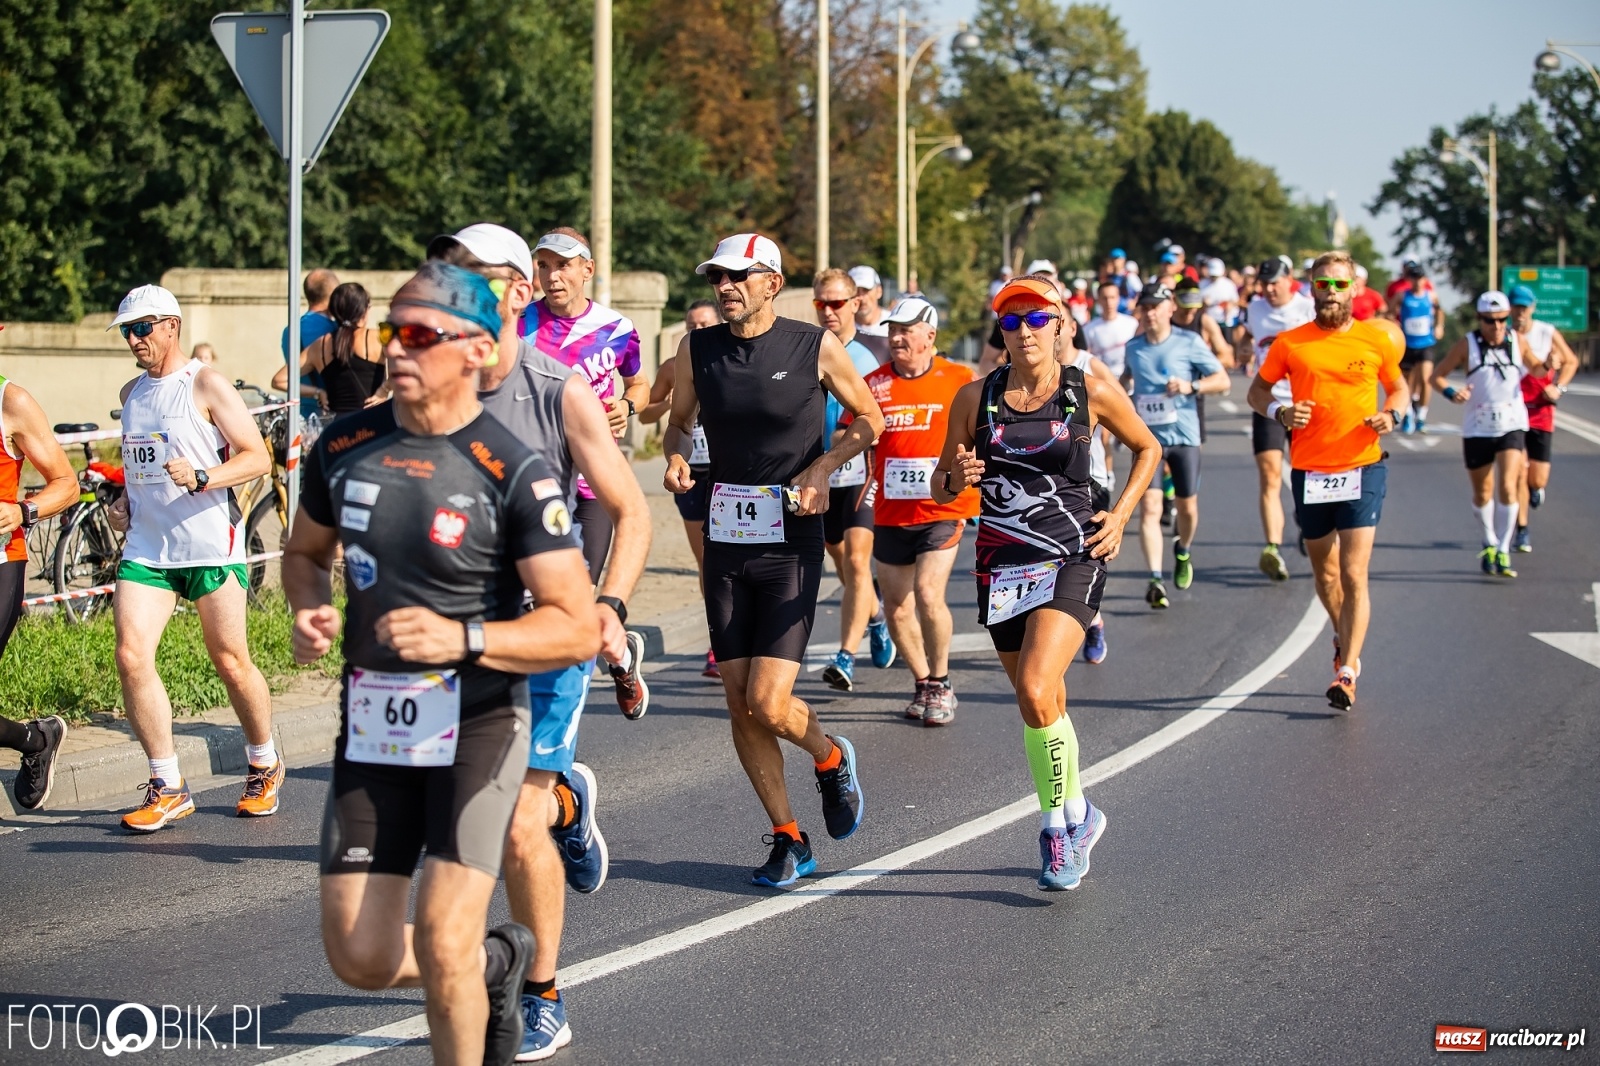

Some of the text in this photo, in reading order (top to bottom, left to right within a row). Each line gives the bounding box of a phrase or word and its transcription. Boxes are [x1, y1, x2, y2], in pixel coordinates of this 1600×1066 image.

[771, 371, 788, 380] 4F
[133, 446, 156, 464] 103
[900, 470, 926, 483] 232
[1323, 476, 1347, 489] 227
[735, 501, 758, 521] 14
[385, 696, 417, 726] 60
